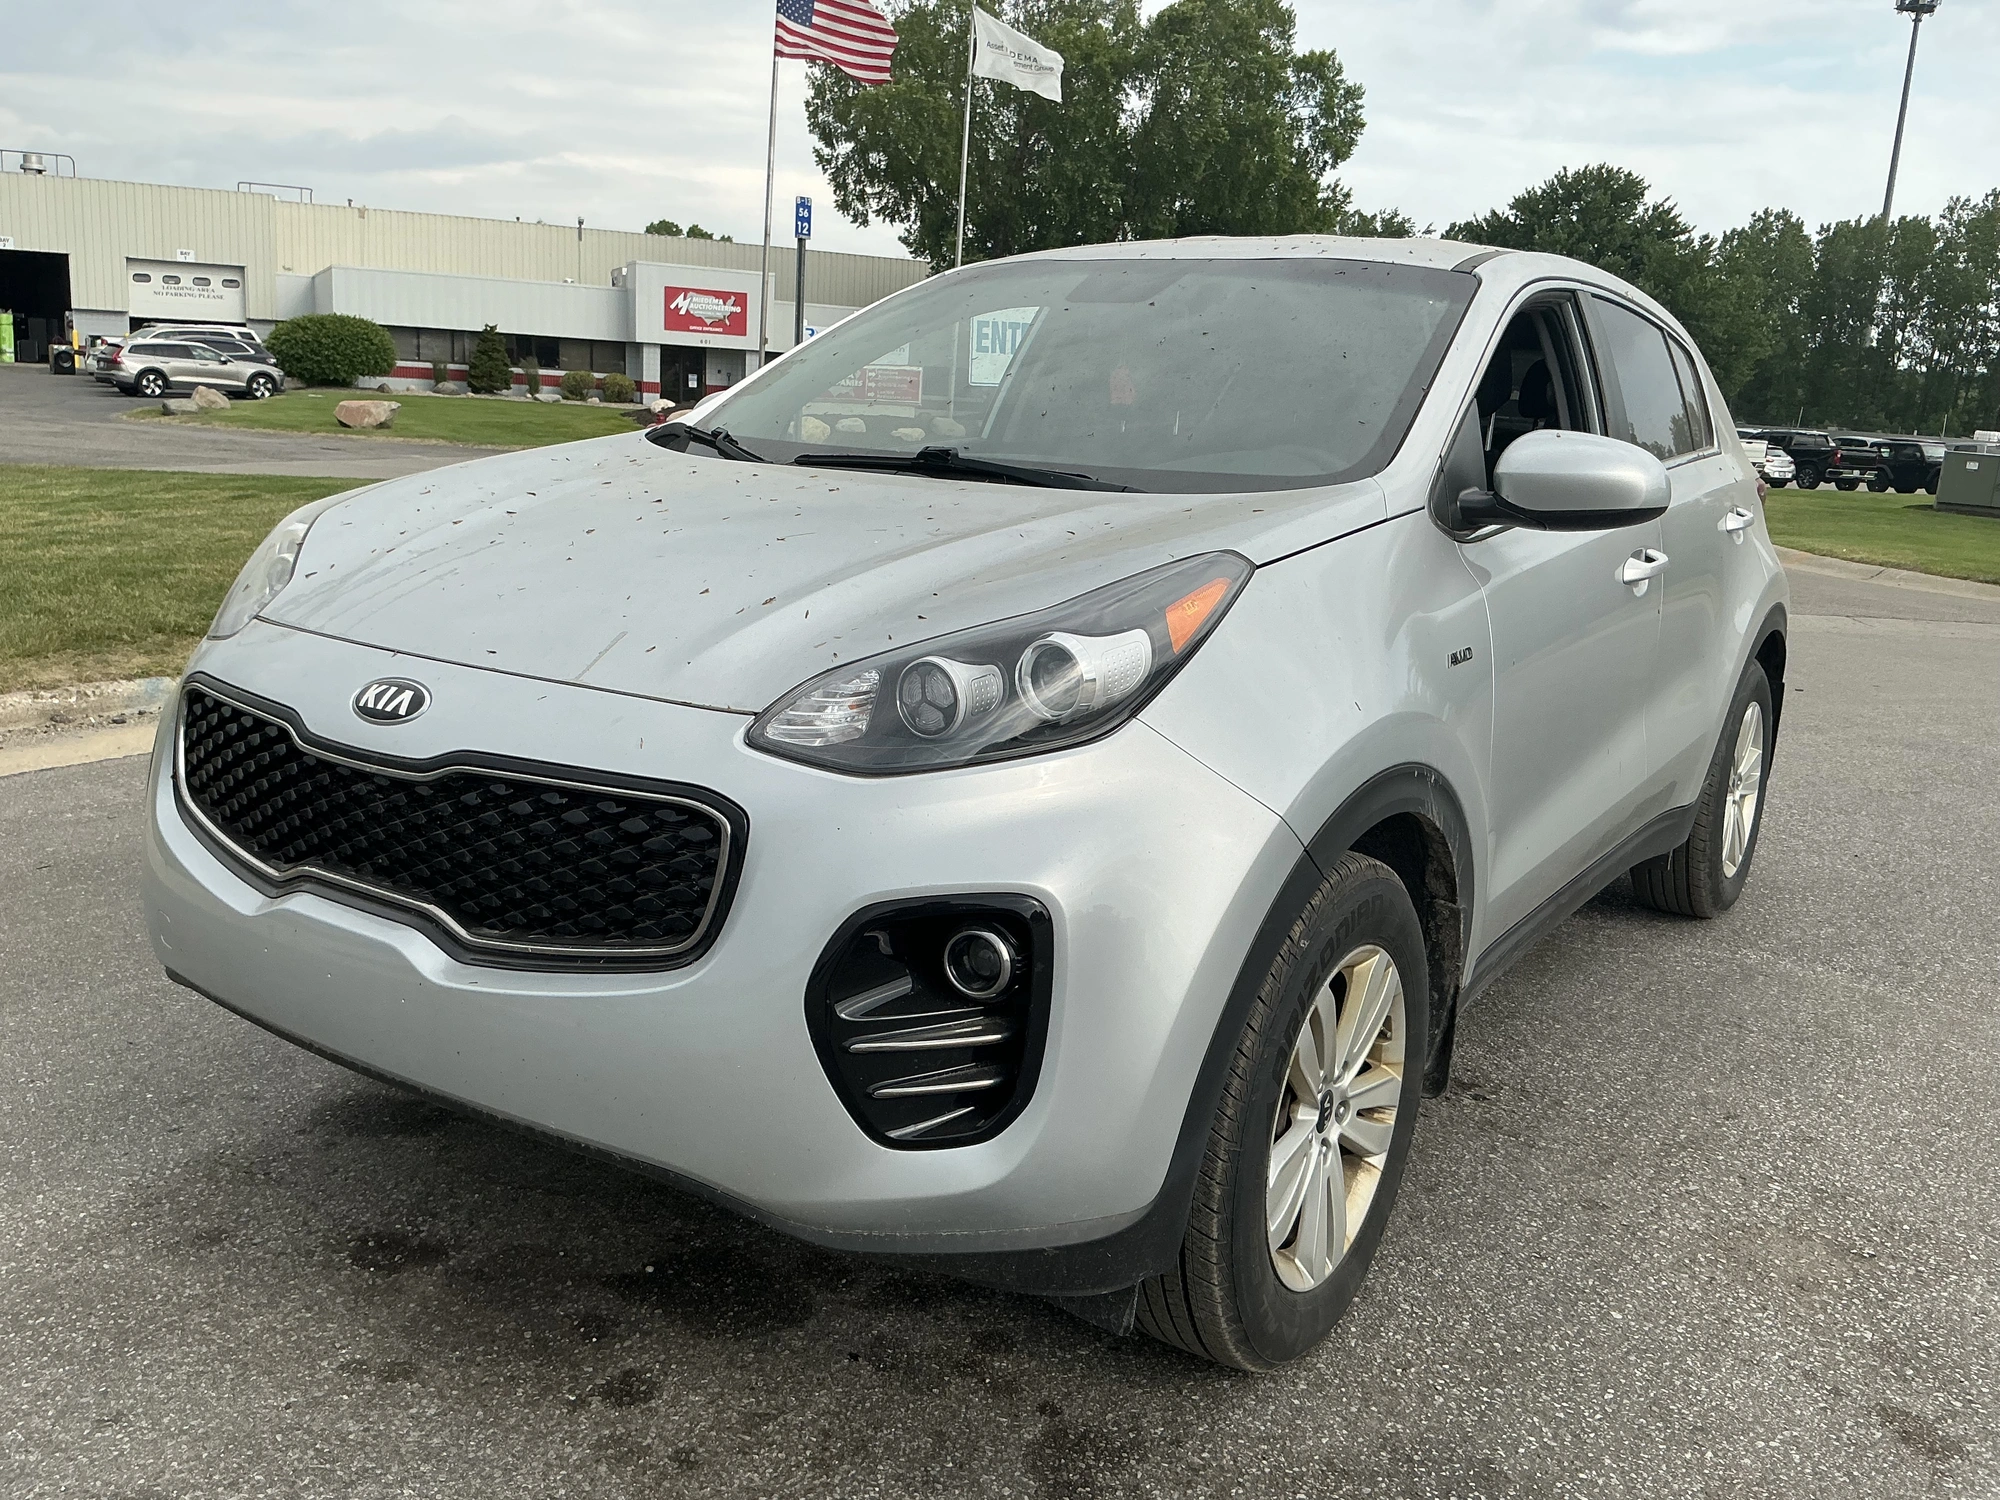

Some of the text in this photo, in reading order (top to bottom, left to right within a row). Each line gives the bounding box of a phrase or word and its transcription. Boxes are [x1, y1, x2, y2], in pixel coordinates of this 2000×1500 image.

[986, 40, 1005, 52] Asset
[798, 207, 809, 218] 56
[797, 221, 809, 234] 12
[692, 296, 723, 305] MIEDEMA
[689, 303, 742, 313] AUCTIONEERING
[358, 683, 415, 716] KIA
